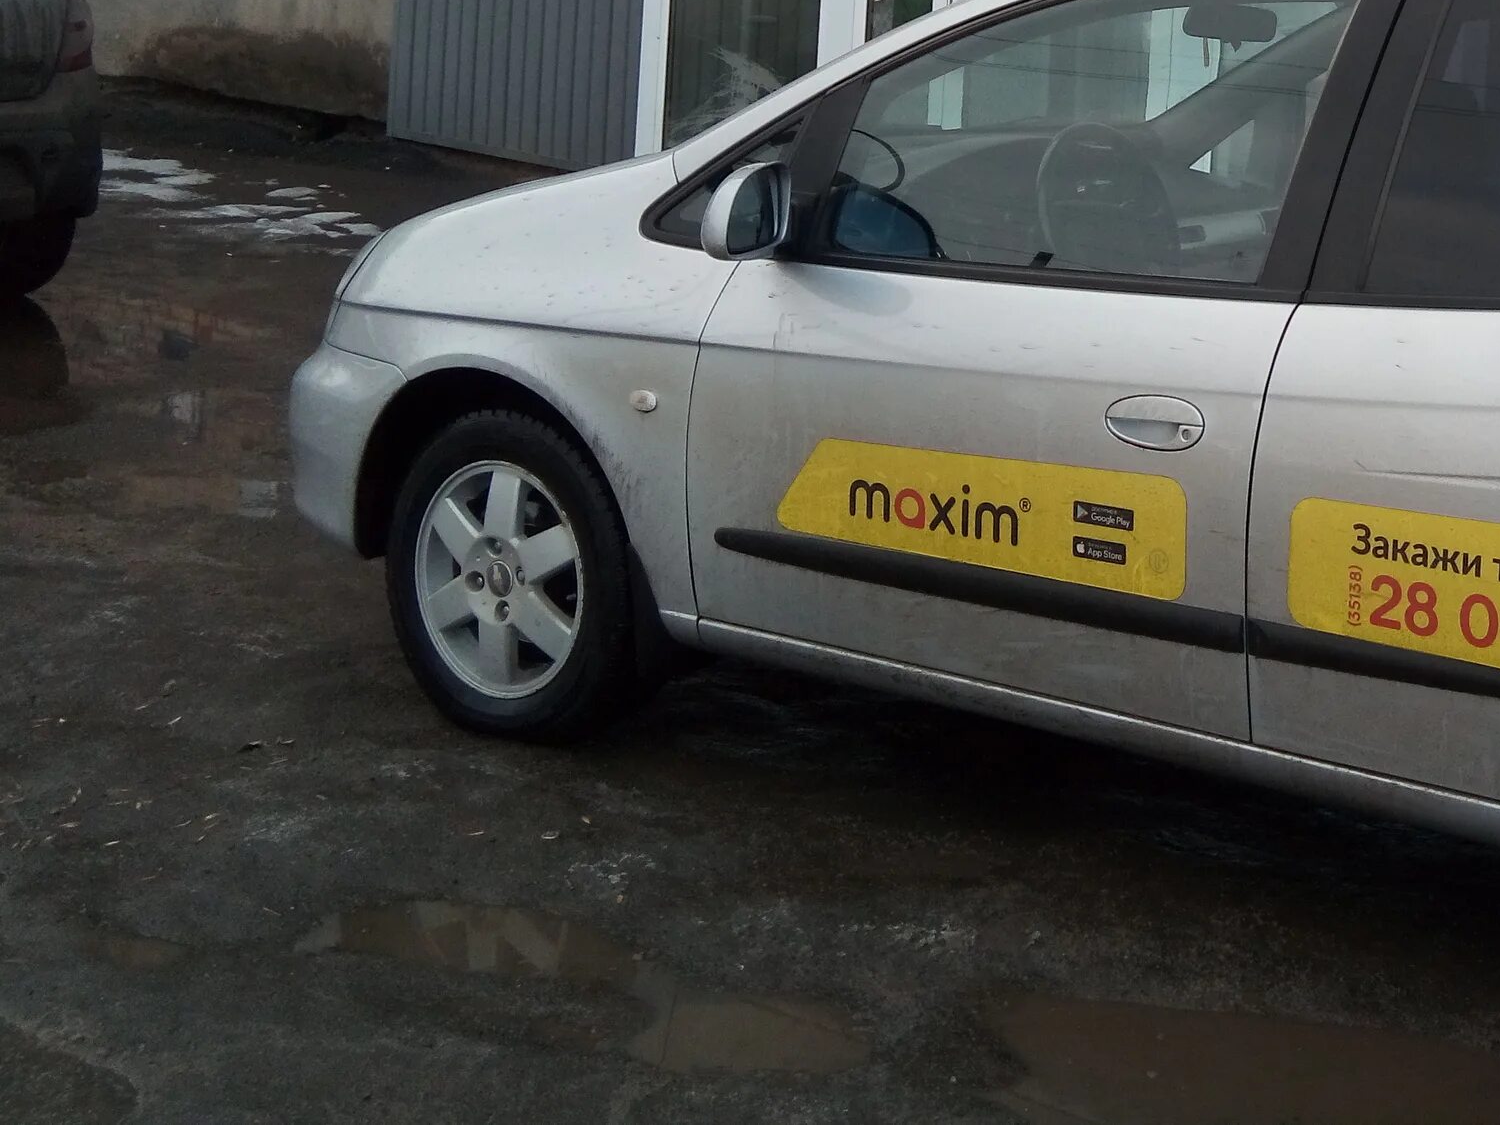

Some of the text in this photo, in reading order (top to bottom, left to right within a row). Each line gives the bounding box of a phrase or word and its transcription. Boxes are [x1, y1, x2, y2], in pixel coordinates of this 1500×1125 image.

[1090, 512, 1131, 528] Google Play
[1087, 547, 1123, 561] App Store
[1350, 523, 1483, 578] Закажи
[1346, 564, 1364, 627] (35138)
[1369, 574, 1440, 637] 28
